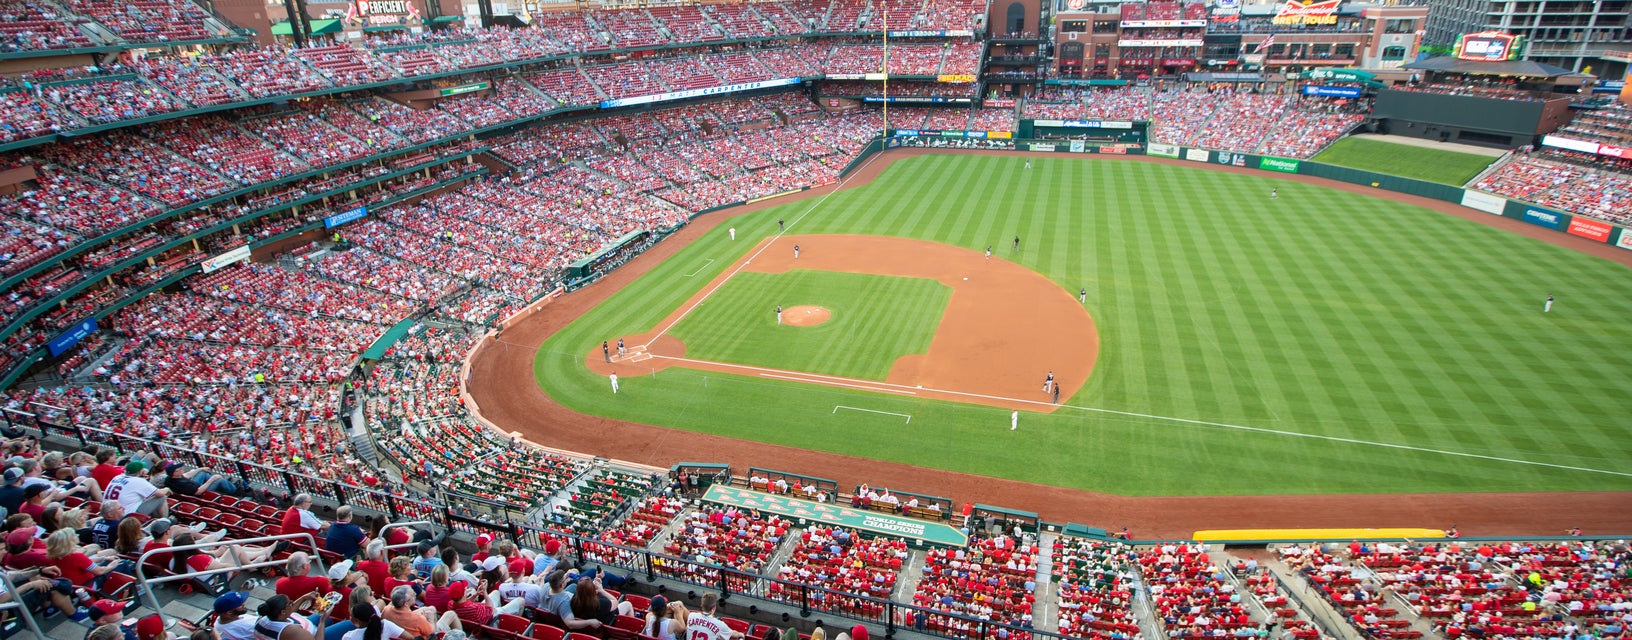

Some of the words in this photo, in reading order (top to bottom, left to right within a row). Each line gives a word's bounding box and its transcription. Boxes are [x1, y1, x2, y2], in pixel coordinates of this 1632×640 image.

[1281, 4, 1338, 16] Budweiser
[370, 15, 398, 24] PERCH
[1273, 15, 1301, 25] BREW
[1303, 15, 1338, 25] HOUSE
[703, 82, 761, 95] CARPENTER
[1270, 160, 1297, 168] National
[105, 485, 122, 500] 16
[862, 520, 925, 536] CHAMPIONS
[865, 515, 896, 525] WORLD
[897, 521, 926, 530] SERIES
[688, 618, 720, 636] CARPENTER
